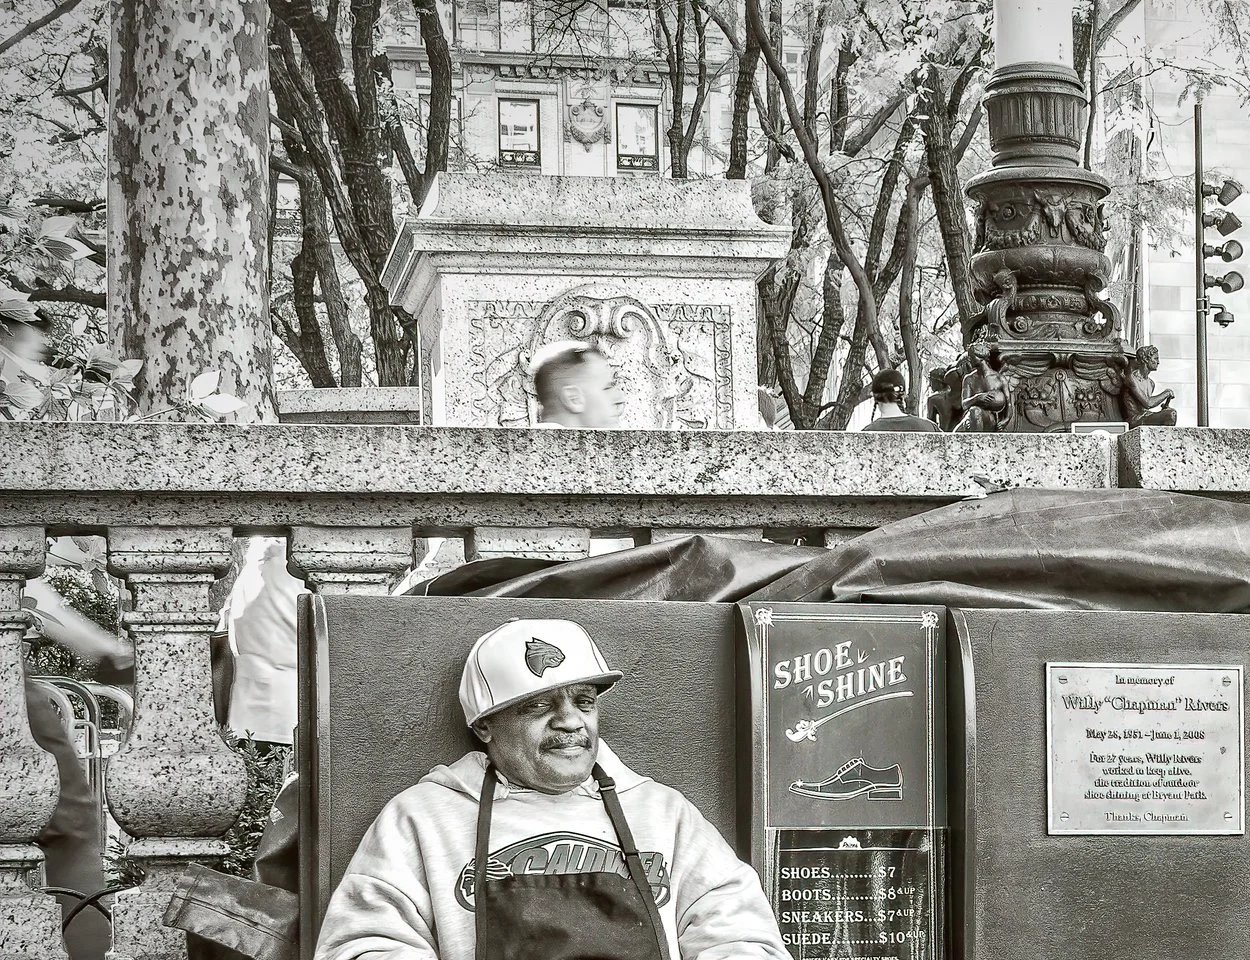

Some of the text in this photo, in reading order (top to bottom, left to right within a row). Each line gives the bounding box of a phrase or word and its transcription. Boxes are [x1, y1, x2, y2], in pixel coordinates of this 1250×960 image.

[774, 640, 855, 689] SHOE
[816, 655, 908, 708] SHINE
[1127, 676, 1163, 687] memory
[1164, 675, 1175, 685] of
[1062, 695, 1103, 714] Willy
[1184, 697, 1230, 711] Rivers
[1086, 729, 1105, 741] May
[1145, 752, 1172, 765] Willy
[1102, 766, 1134, 775] worked
[1094, 778, 1109, 787] the
[1110, 778, 1151, 787] tradition
